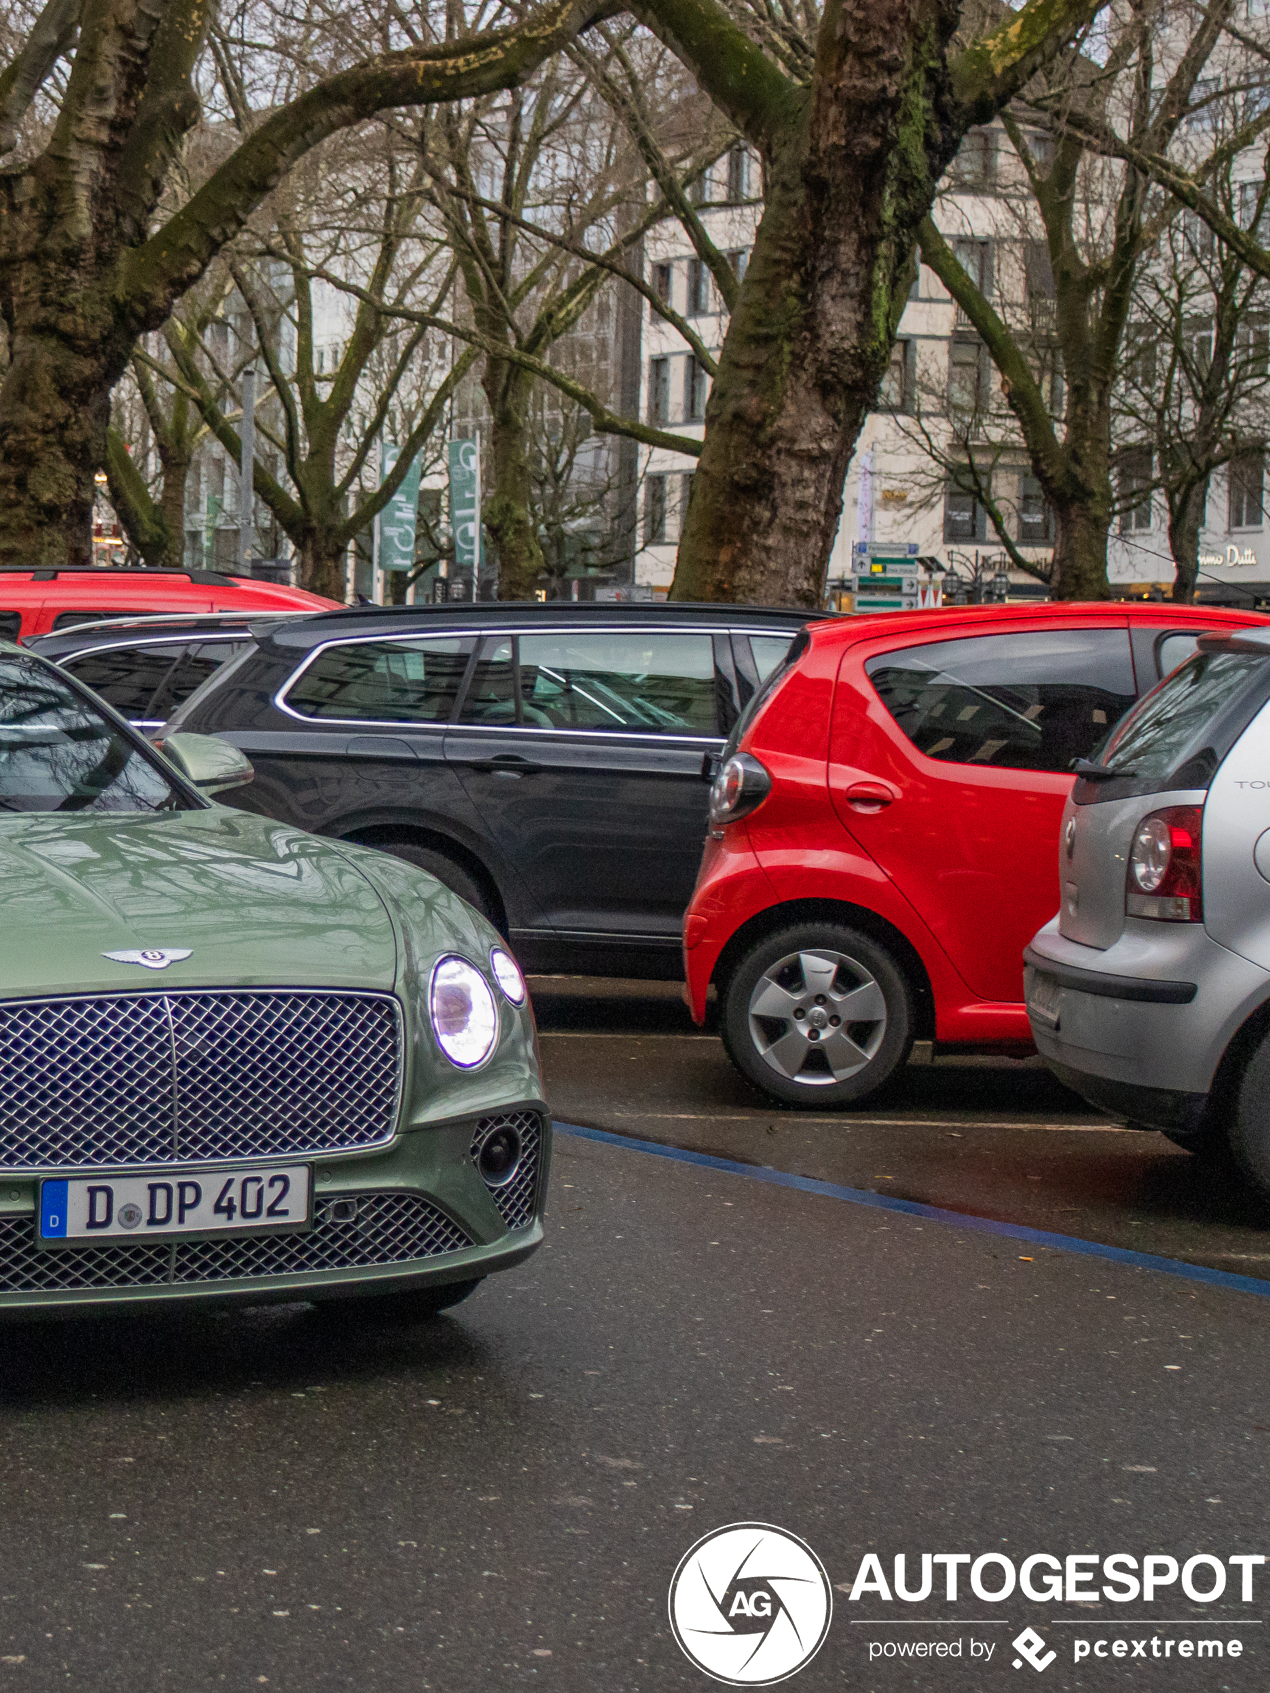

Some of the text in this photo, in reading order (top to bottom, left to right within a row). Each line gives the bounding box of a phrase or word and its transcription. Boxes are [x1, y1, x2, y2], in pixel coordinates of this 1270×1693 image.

[1226, 544, 1257, 567] Dutti
[1234, 780, 1270, 790] TO
[86, 1173, 290, 1230] D DP 402
[49, 1215, 60, 1228] D
